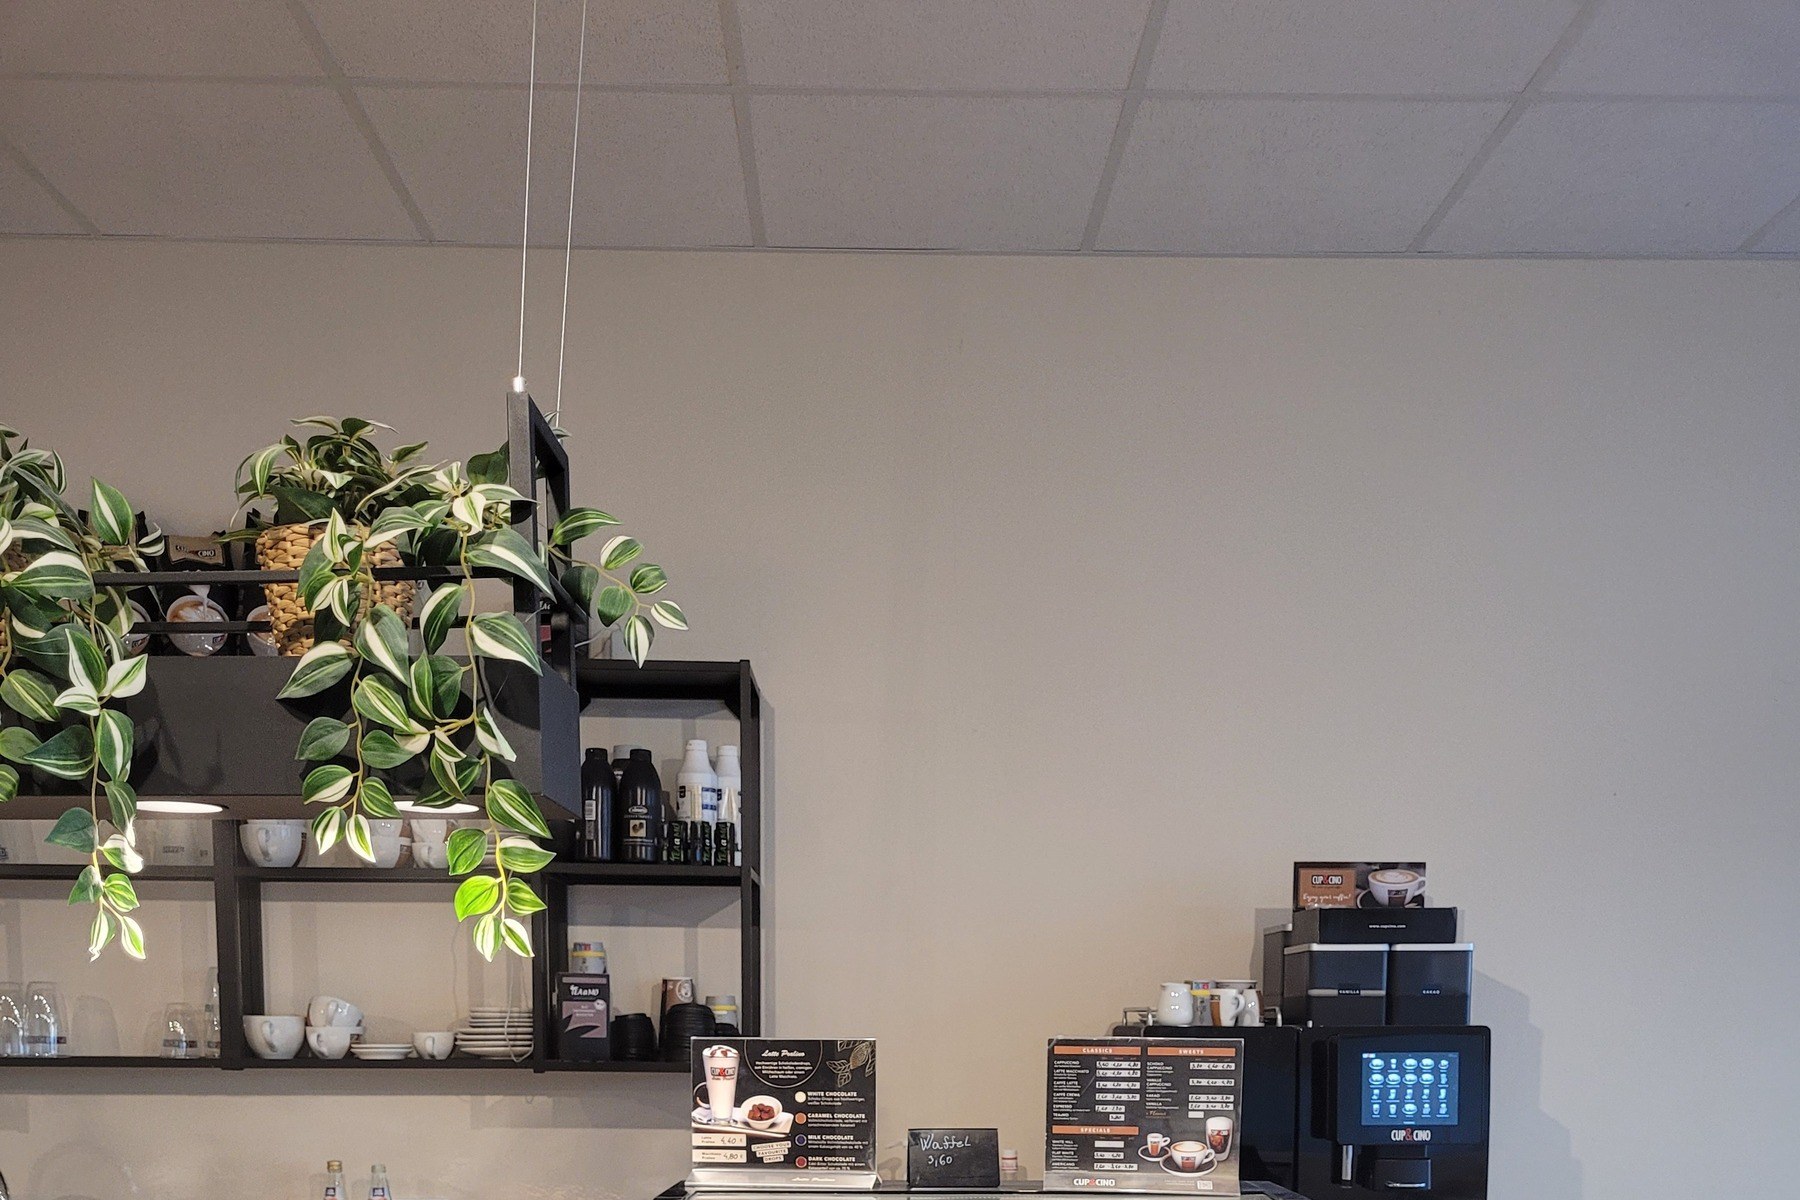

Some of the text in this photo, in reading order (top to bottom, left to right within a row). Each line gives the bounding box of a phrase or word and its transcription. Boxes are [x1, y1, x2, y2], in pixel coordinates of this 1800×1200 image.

[1391, 1128, 1431, 1141] CUP&CINO
[928, 1154, 953, 1167] 3,60
[1074, 1177, 1115, 1186] CUP&CINO
